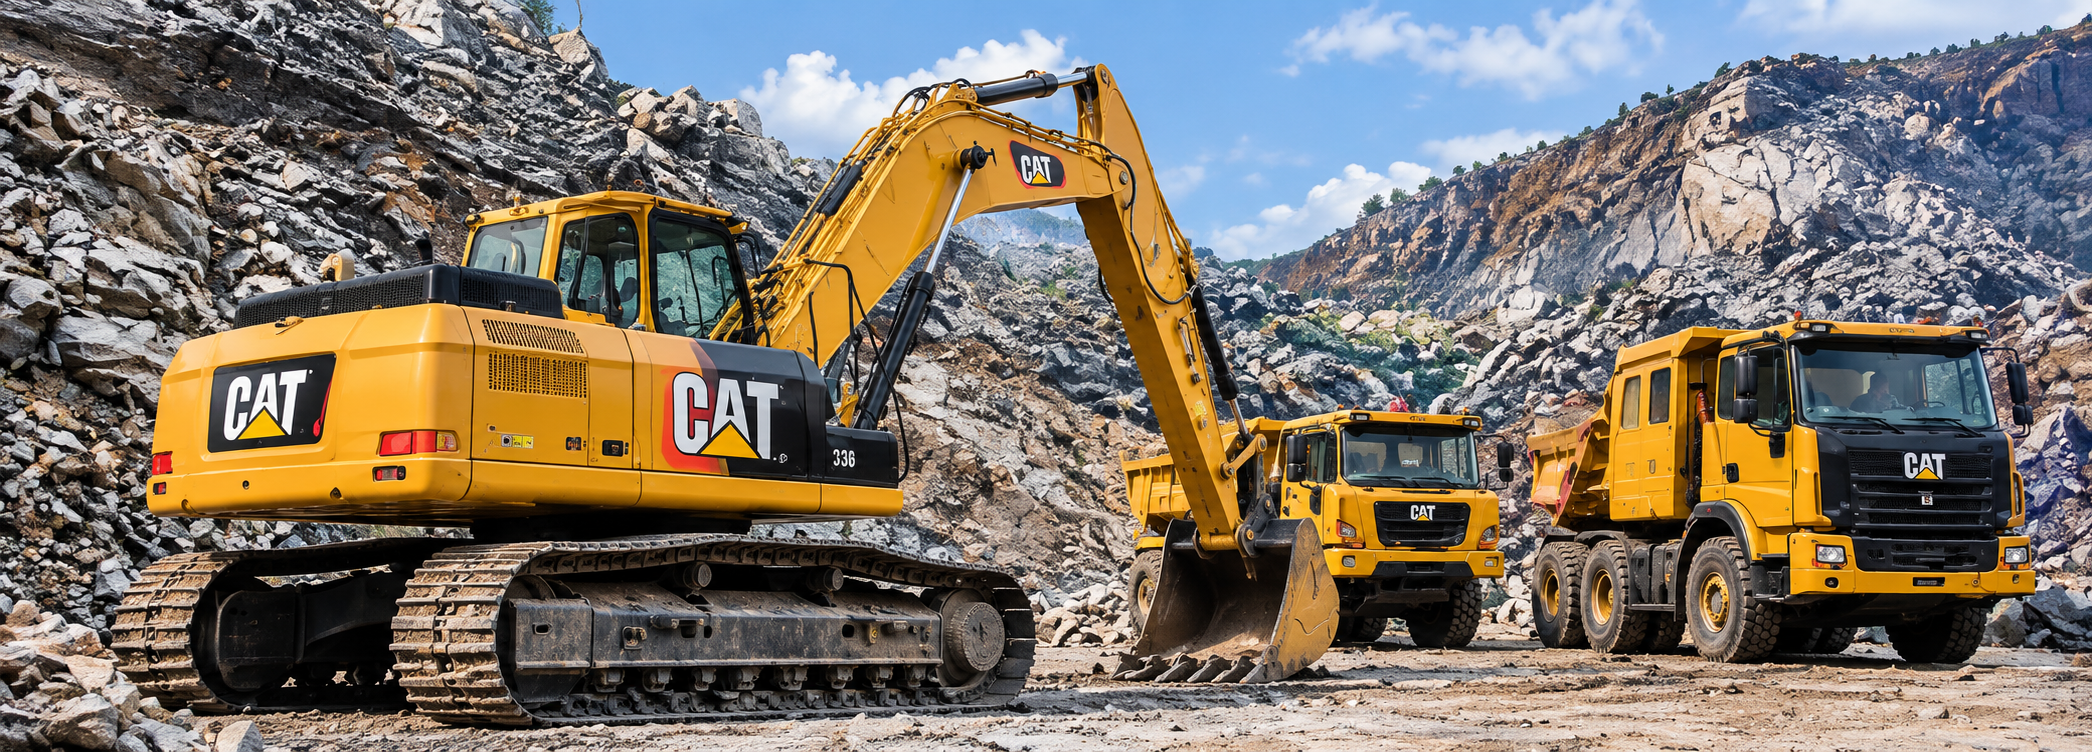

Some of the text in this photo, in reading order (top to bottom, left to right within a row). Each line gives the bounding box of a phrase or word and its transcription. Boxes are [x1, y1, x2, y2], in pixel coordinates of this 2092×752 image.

[1020, 155, 1052, 184] CAT
[223, 369, 308, 441] CAT
[673, 372, 780, 460] CAT
[833, 449, 856, 468] 336
[1903, 452, 1946, 480] CAT
[1410, 504, 1436, 521] CAT
